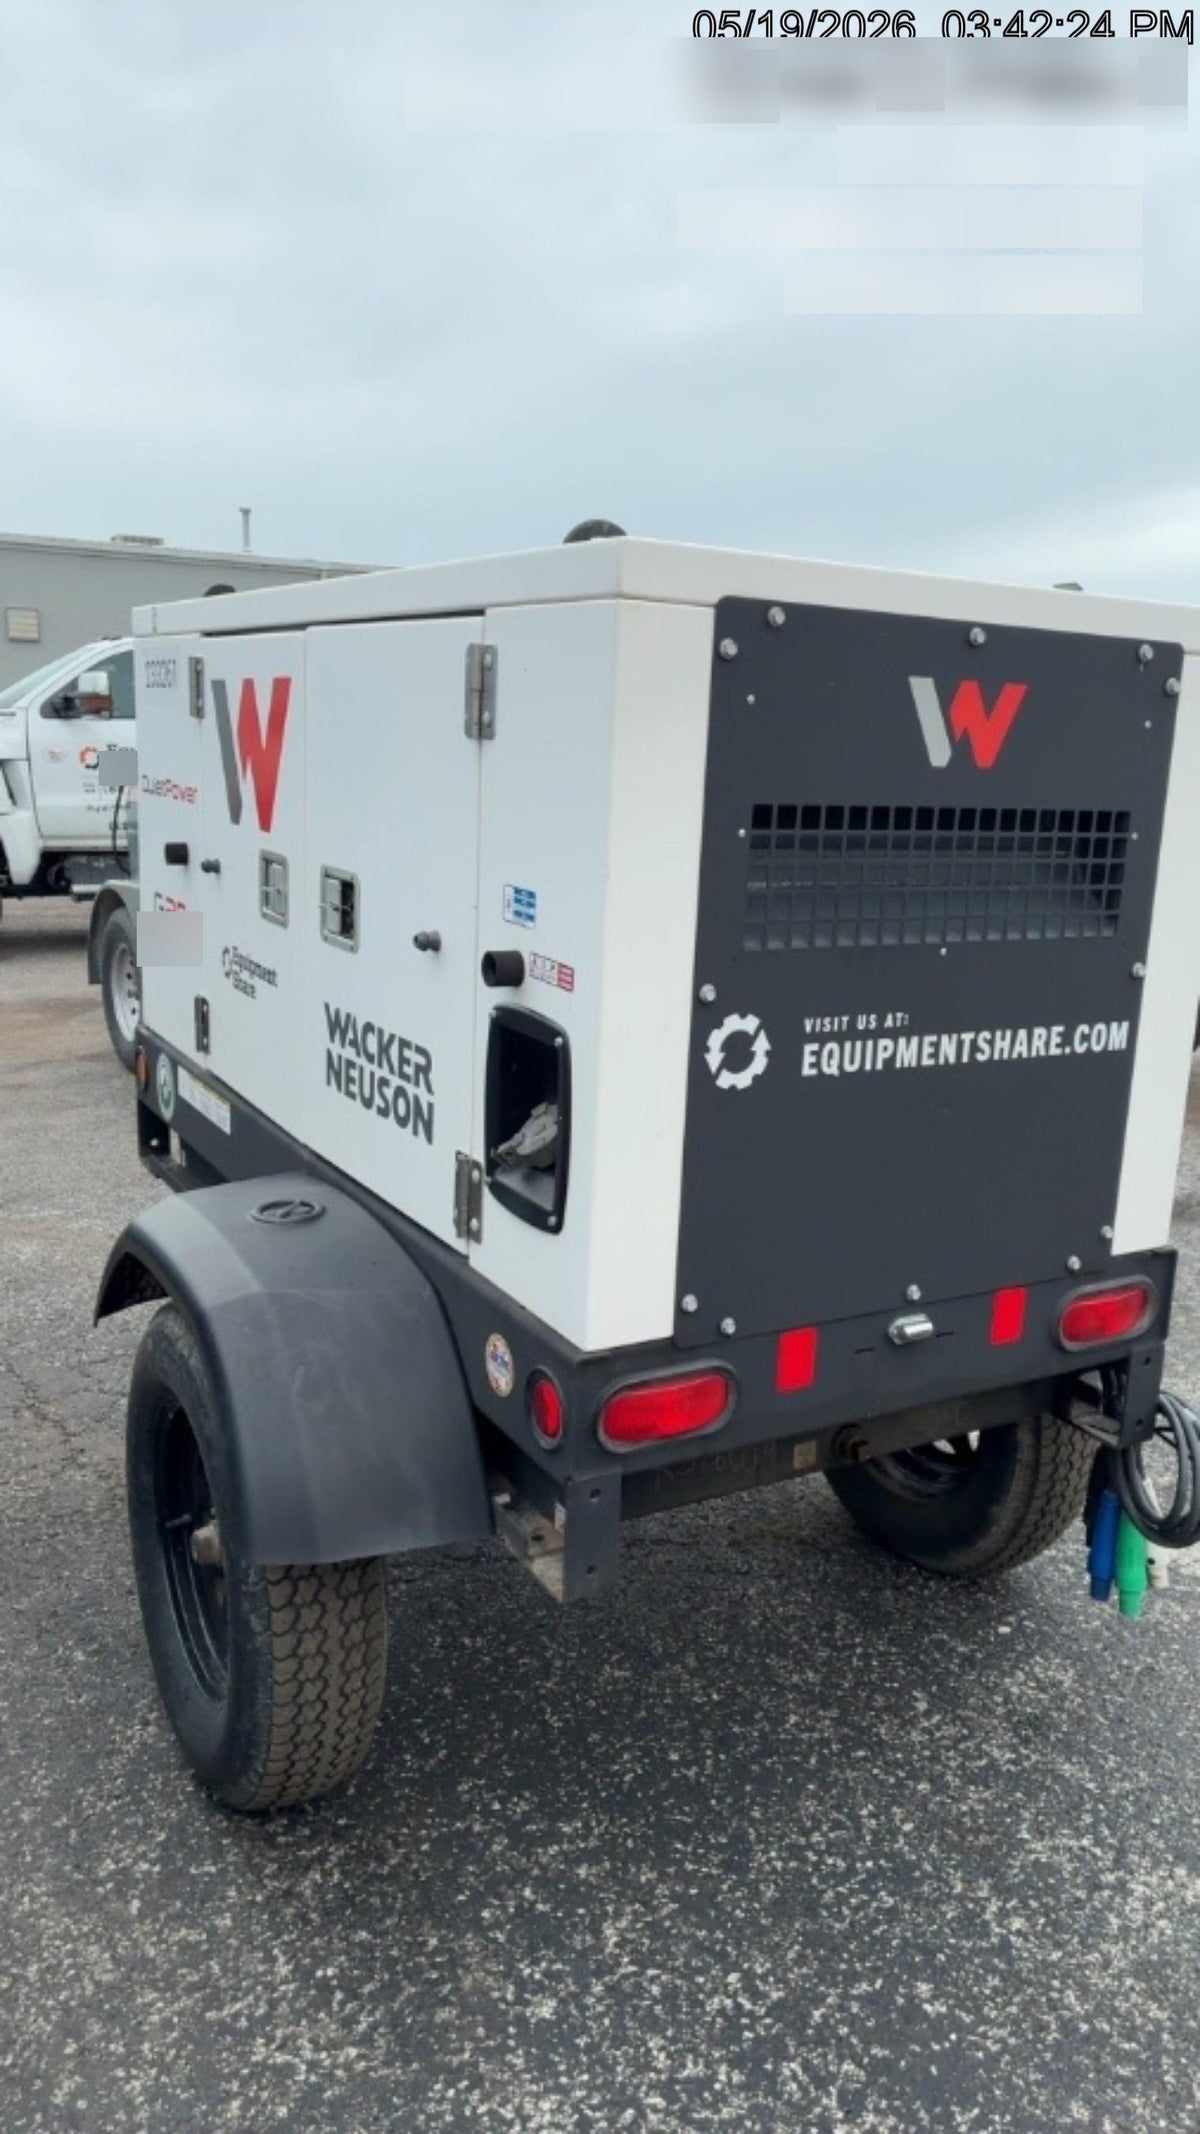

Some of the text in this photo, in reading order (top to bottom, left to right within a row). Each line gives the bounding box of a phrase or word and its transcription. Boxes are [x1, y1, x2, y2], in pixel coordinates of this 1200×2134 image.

[232, 945, 278, 989] Equipment
[324, 1001, 434, 1096] WACKER
[801, 1020, 1130, 1077] EQUIPMENTSHARE.COM
[803, 1012, 909, 1034] VISIT US AT:
[326, 1047, 434, 1146] NEUSON
